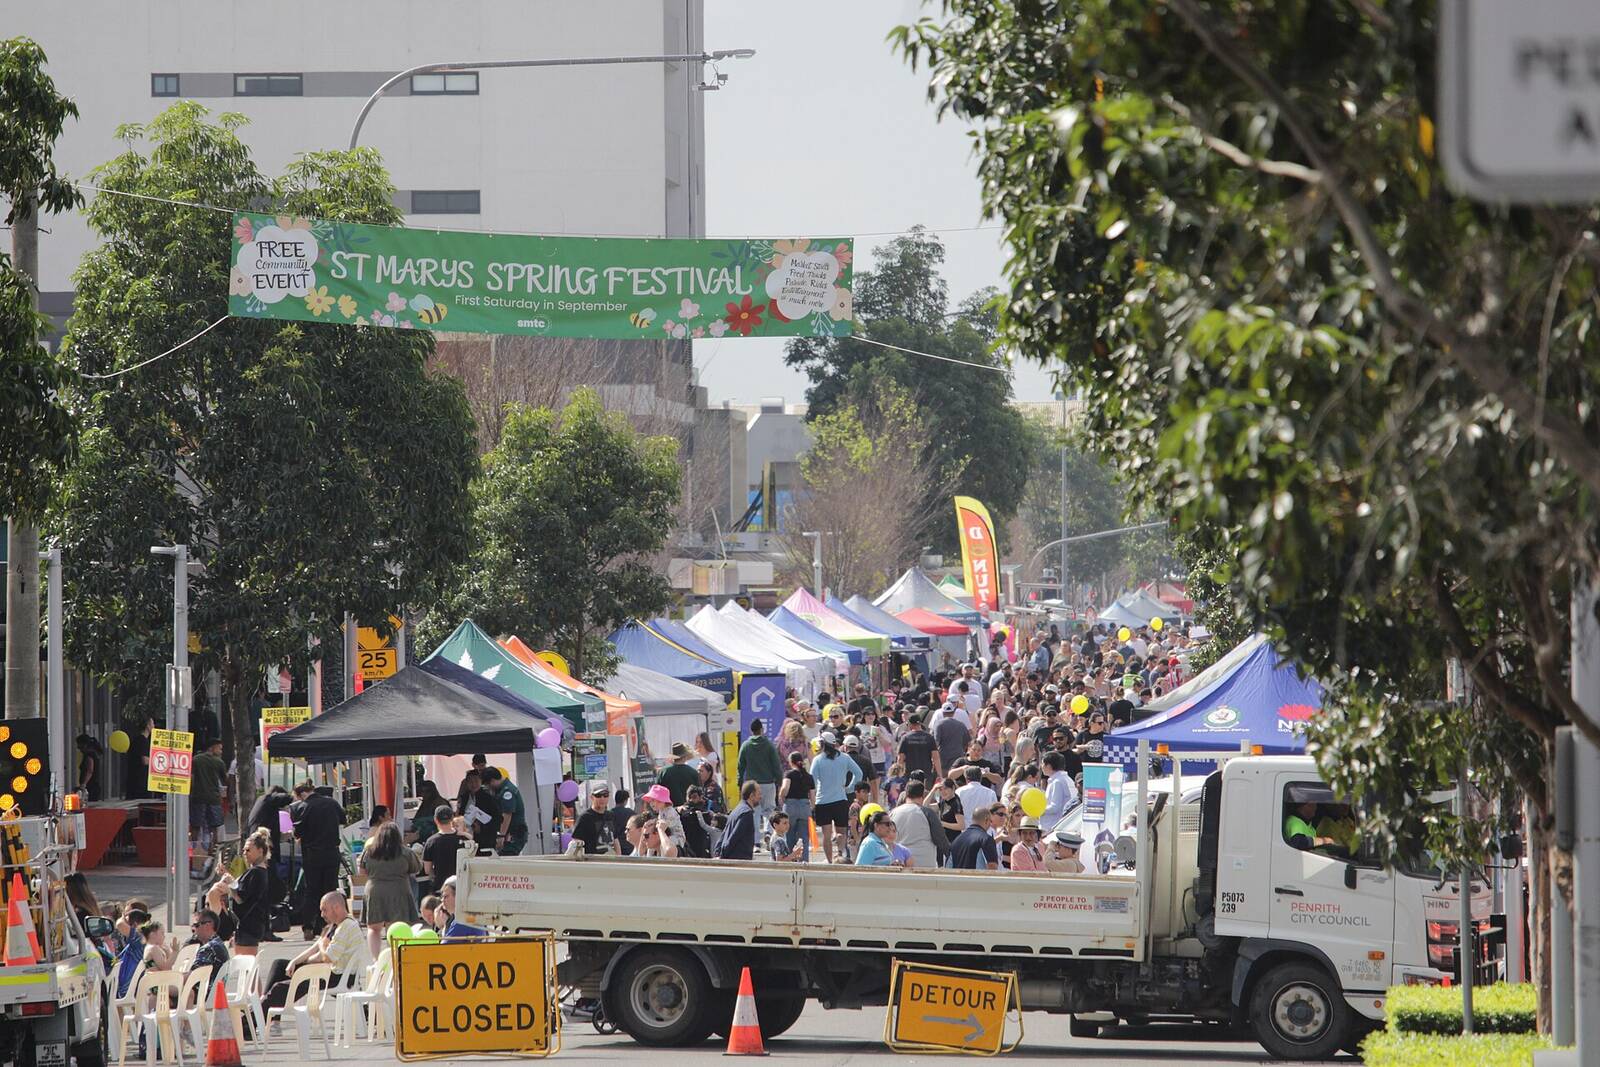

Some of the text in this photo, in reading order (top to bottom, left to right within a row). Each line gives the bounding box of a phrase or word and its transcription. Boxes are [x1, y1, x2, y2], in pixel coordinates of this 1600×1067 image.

[256, 241, 306, 258] FREE
[255, 259, 310, 272] Community
[331, 251, 753, 296] ST MARYS SPRING FESTIVAL
[252, 273, 309, 290] EVENT
[455, 295, 627, 313] First Saturday in September
[517, 318, 545, 329] smtc
[361, 652, 387, 668] 25
[290, 708, 306, 716] EVENT
[170, 753, 190, 770] NO
[1046, 895, 1074, 903] PEOPLE
[1222, 892, 1245, 903] P5073
[1068, 903, 1093, 911] GATES
[1222, 903, 1236, 913] 239
[1291, 902, 1341, 913] PENRITH
[1290, 913, 1371, 927] CITY COUNCIL
[429, 961, 516, 991] ROAD
[910, 983, 996, 1011] DETOUR
[412, 1003, 535, 1034] CLOSED
